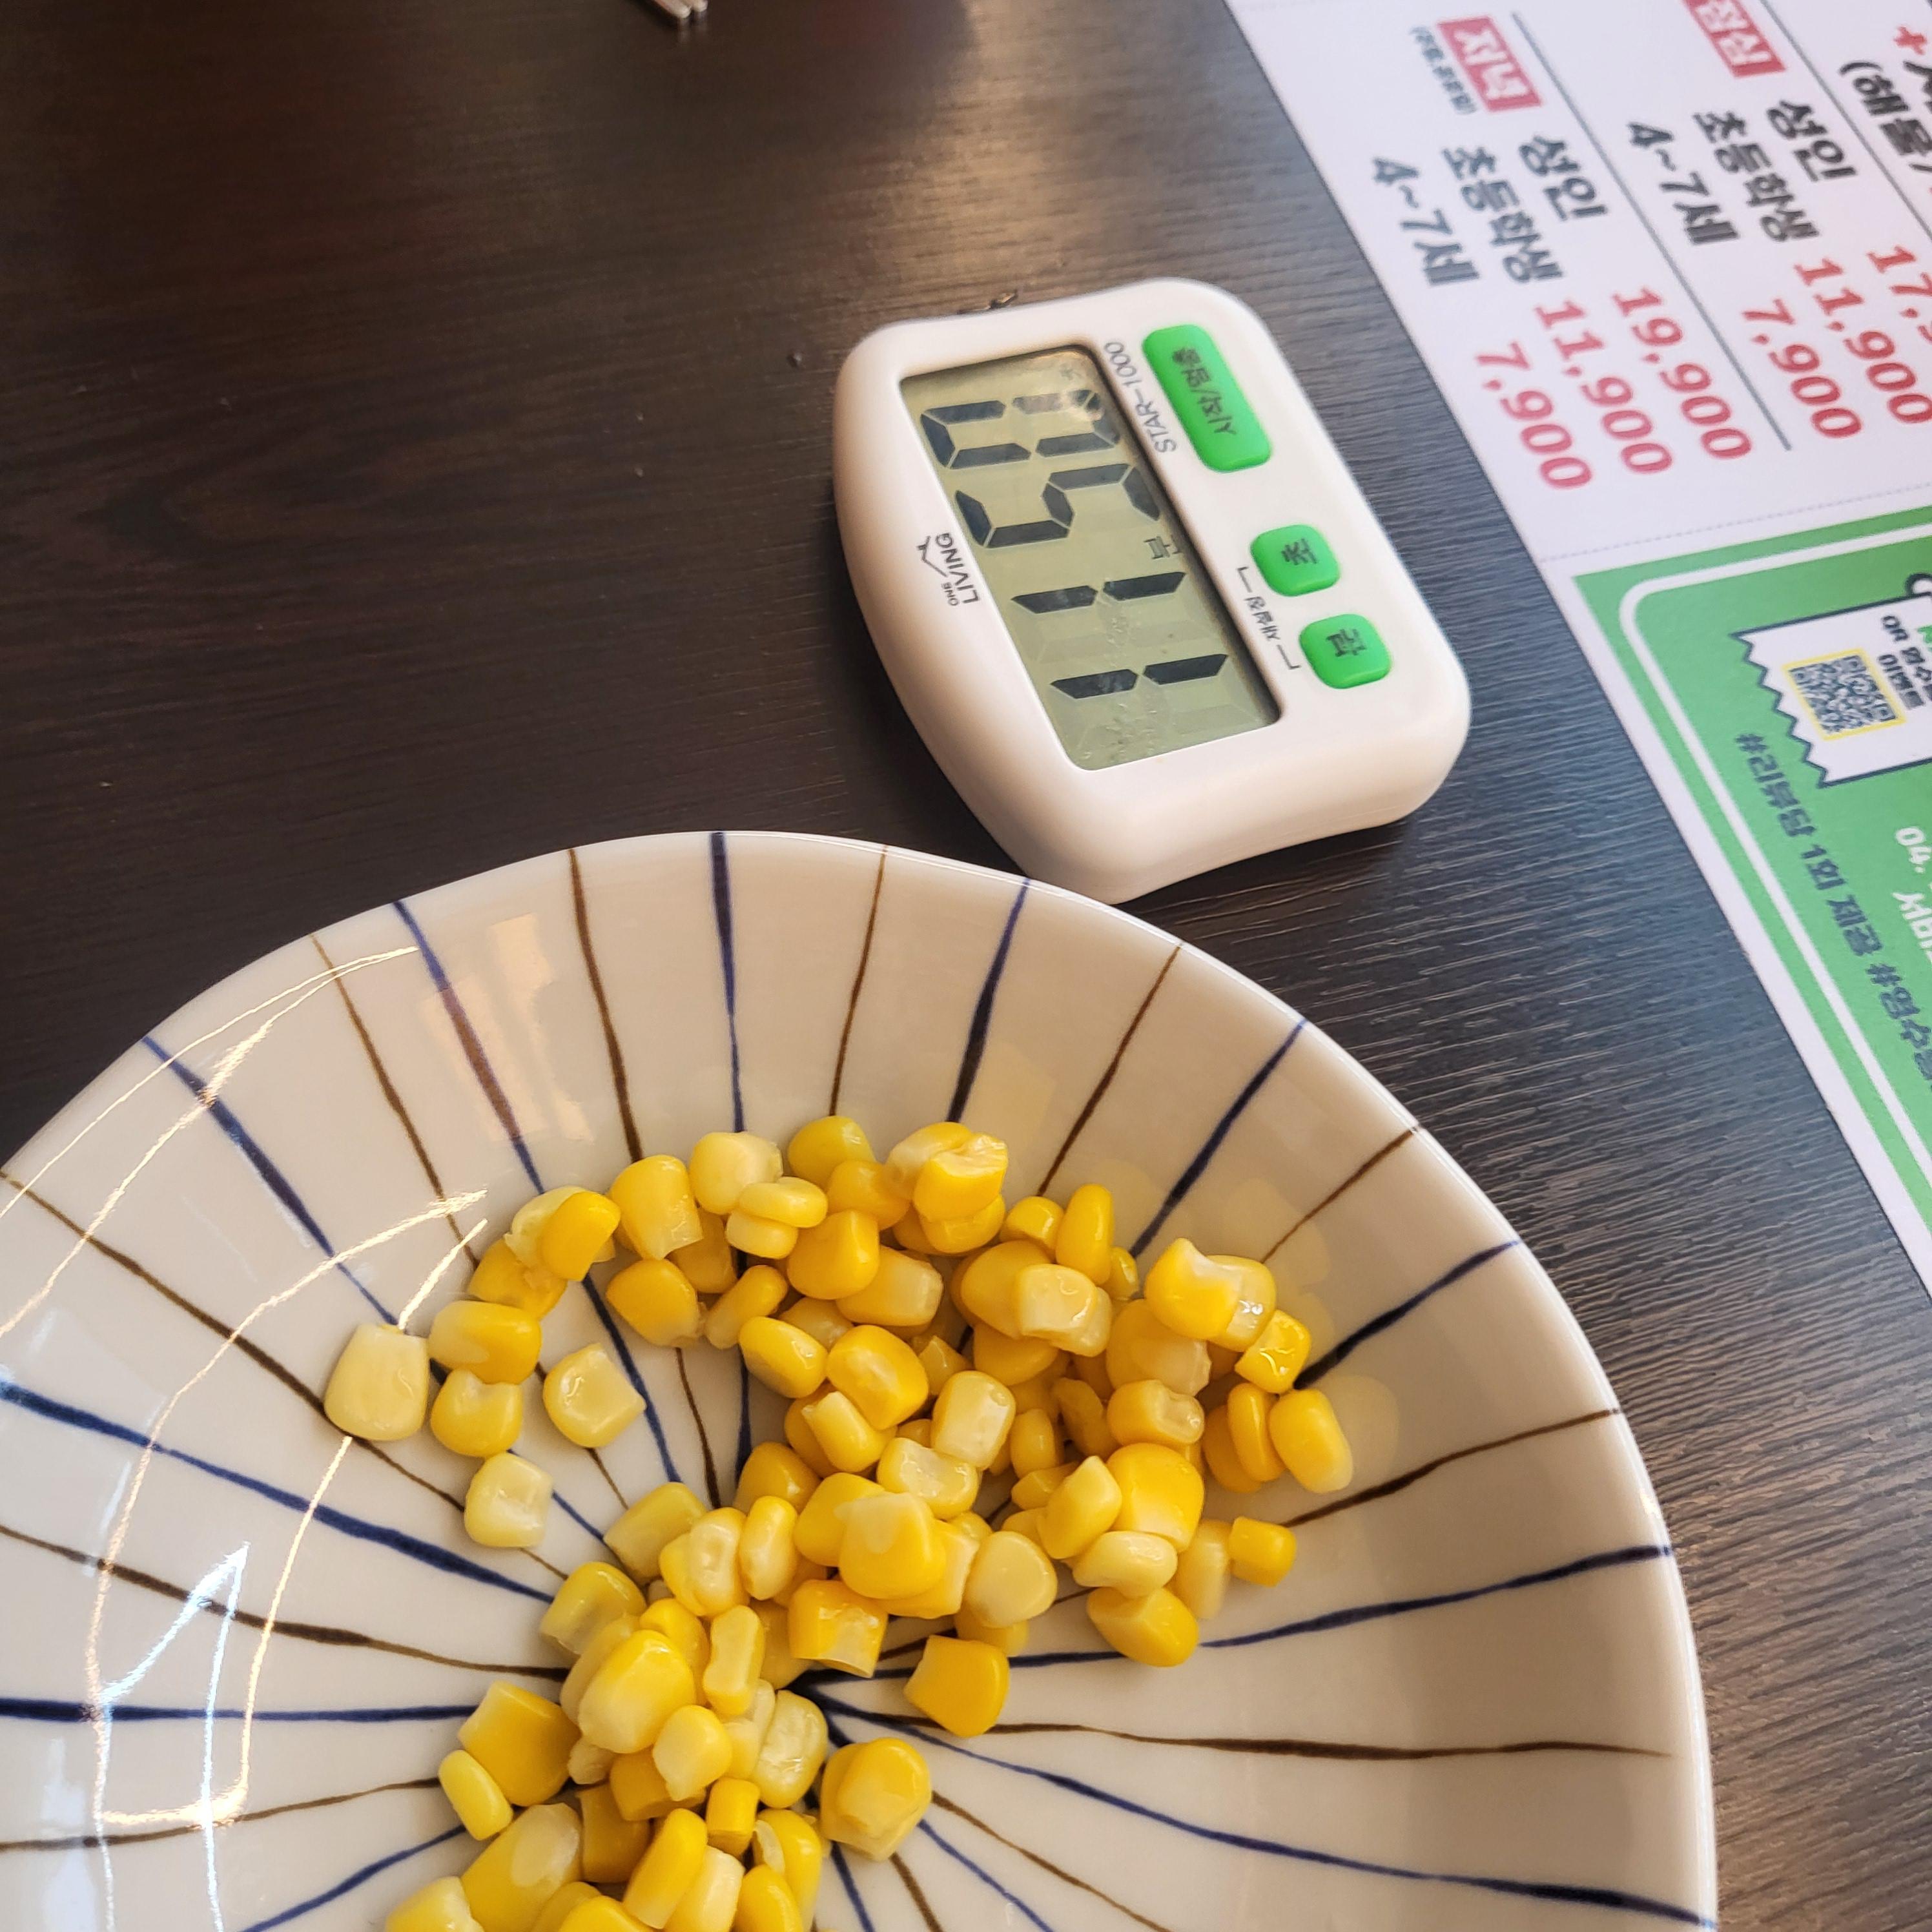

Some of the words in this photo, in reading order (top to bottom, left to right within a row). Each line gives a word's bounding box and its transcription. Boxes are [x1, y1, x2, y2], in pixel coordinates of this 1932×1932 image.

[1453, 28, 1529, 98] 저녁
[1694, 0, 1772, 65] 점심
[1766, 99, 1858, 182] 성인
[1865, 244, 1932, 344] 17,
[1517, 135, 1608, 221] 성인
[1612, 286, 1752, 460] 19,900
[1626, 121, 1742, 246] 4~7세
[1742, 298, 1863, 440] 7,900
[1692, 109, 1820, 243] 초등학생
[1793, 257, 1932, 426] 11,900
[1372, 156, 1480, 287] 4~7세
[1475, 341, 1592, 490] 7,900
[1441, 145, 1565, 284] 초등학생
[1534, 300, 1673, 475] 11,900
[1104, 342, 1177, 453] STAR-1000
[1171, 347, 1236, 435] 시작/멈춤
[935, 533, 980, 604] LIVING
[1281, 538, 1317, 566] 초
[941, 582, 959, 606] ONE
[1244, 596, 1280, 641] 재설정
[1326, 628, 1367, 657] 분
[1895, 826, 1932, 874] 04.
[1801, 844, 1847, 890] 1회
[1826, 894, 1883, 957] 제공
[1892, 892, 1932, 963] 서비
